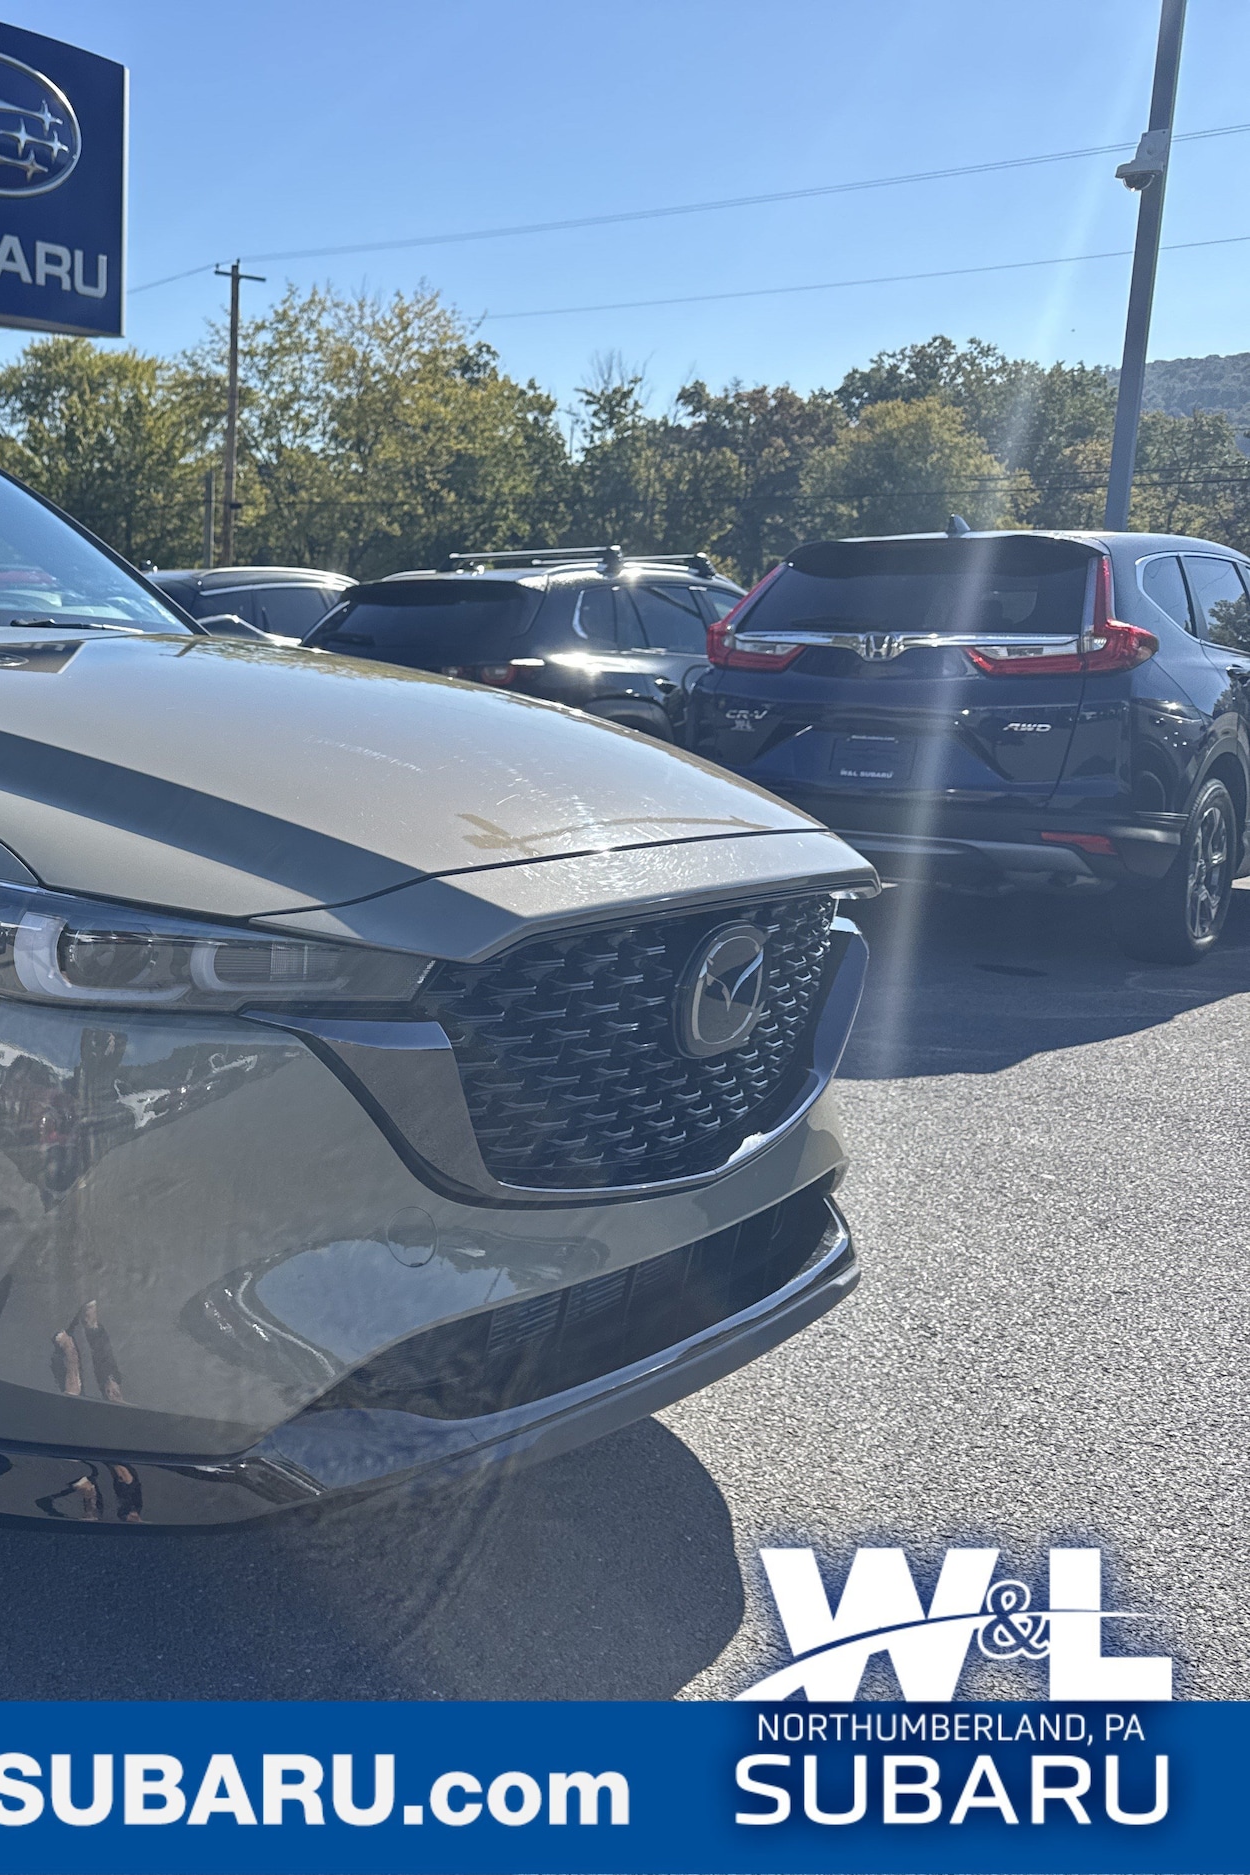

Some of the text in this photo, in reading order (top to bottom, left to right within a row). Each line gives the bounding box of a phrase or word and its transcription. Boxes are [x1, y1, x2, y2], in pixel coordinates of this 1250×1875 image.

[725, 708, 769, 720] CR-V
[1002, 722, 1053, 733] AWD
[859, 769, 895, 780] SUBARU
